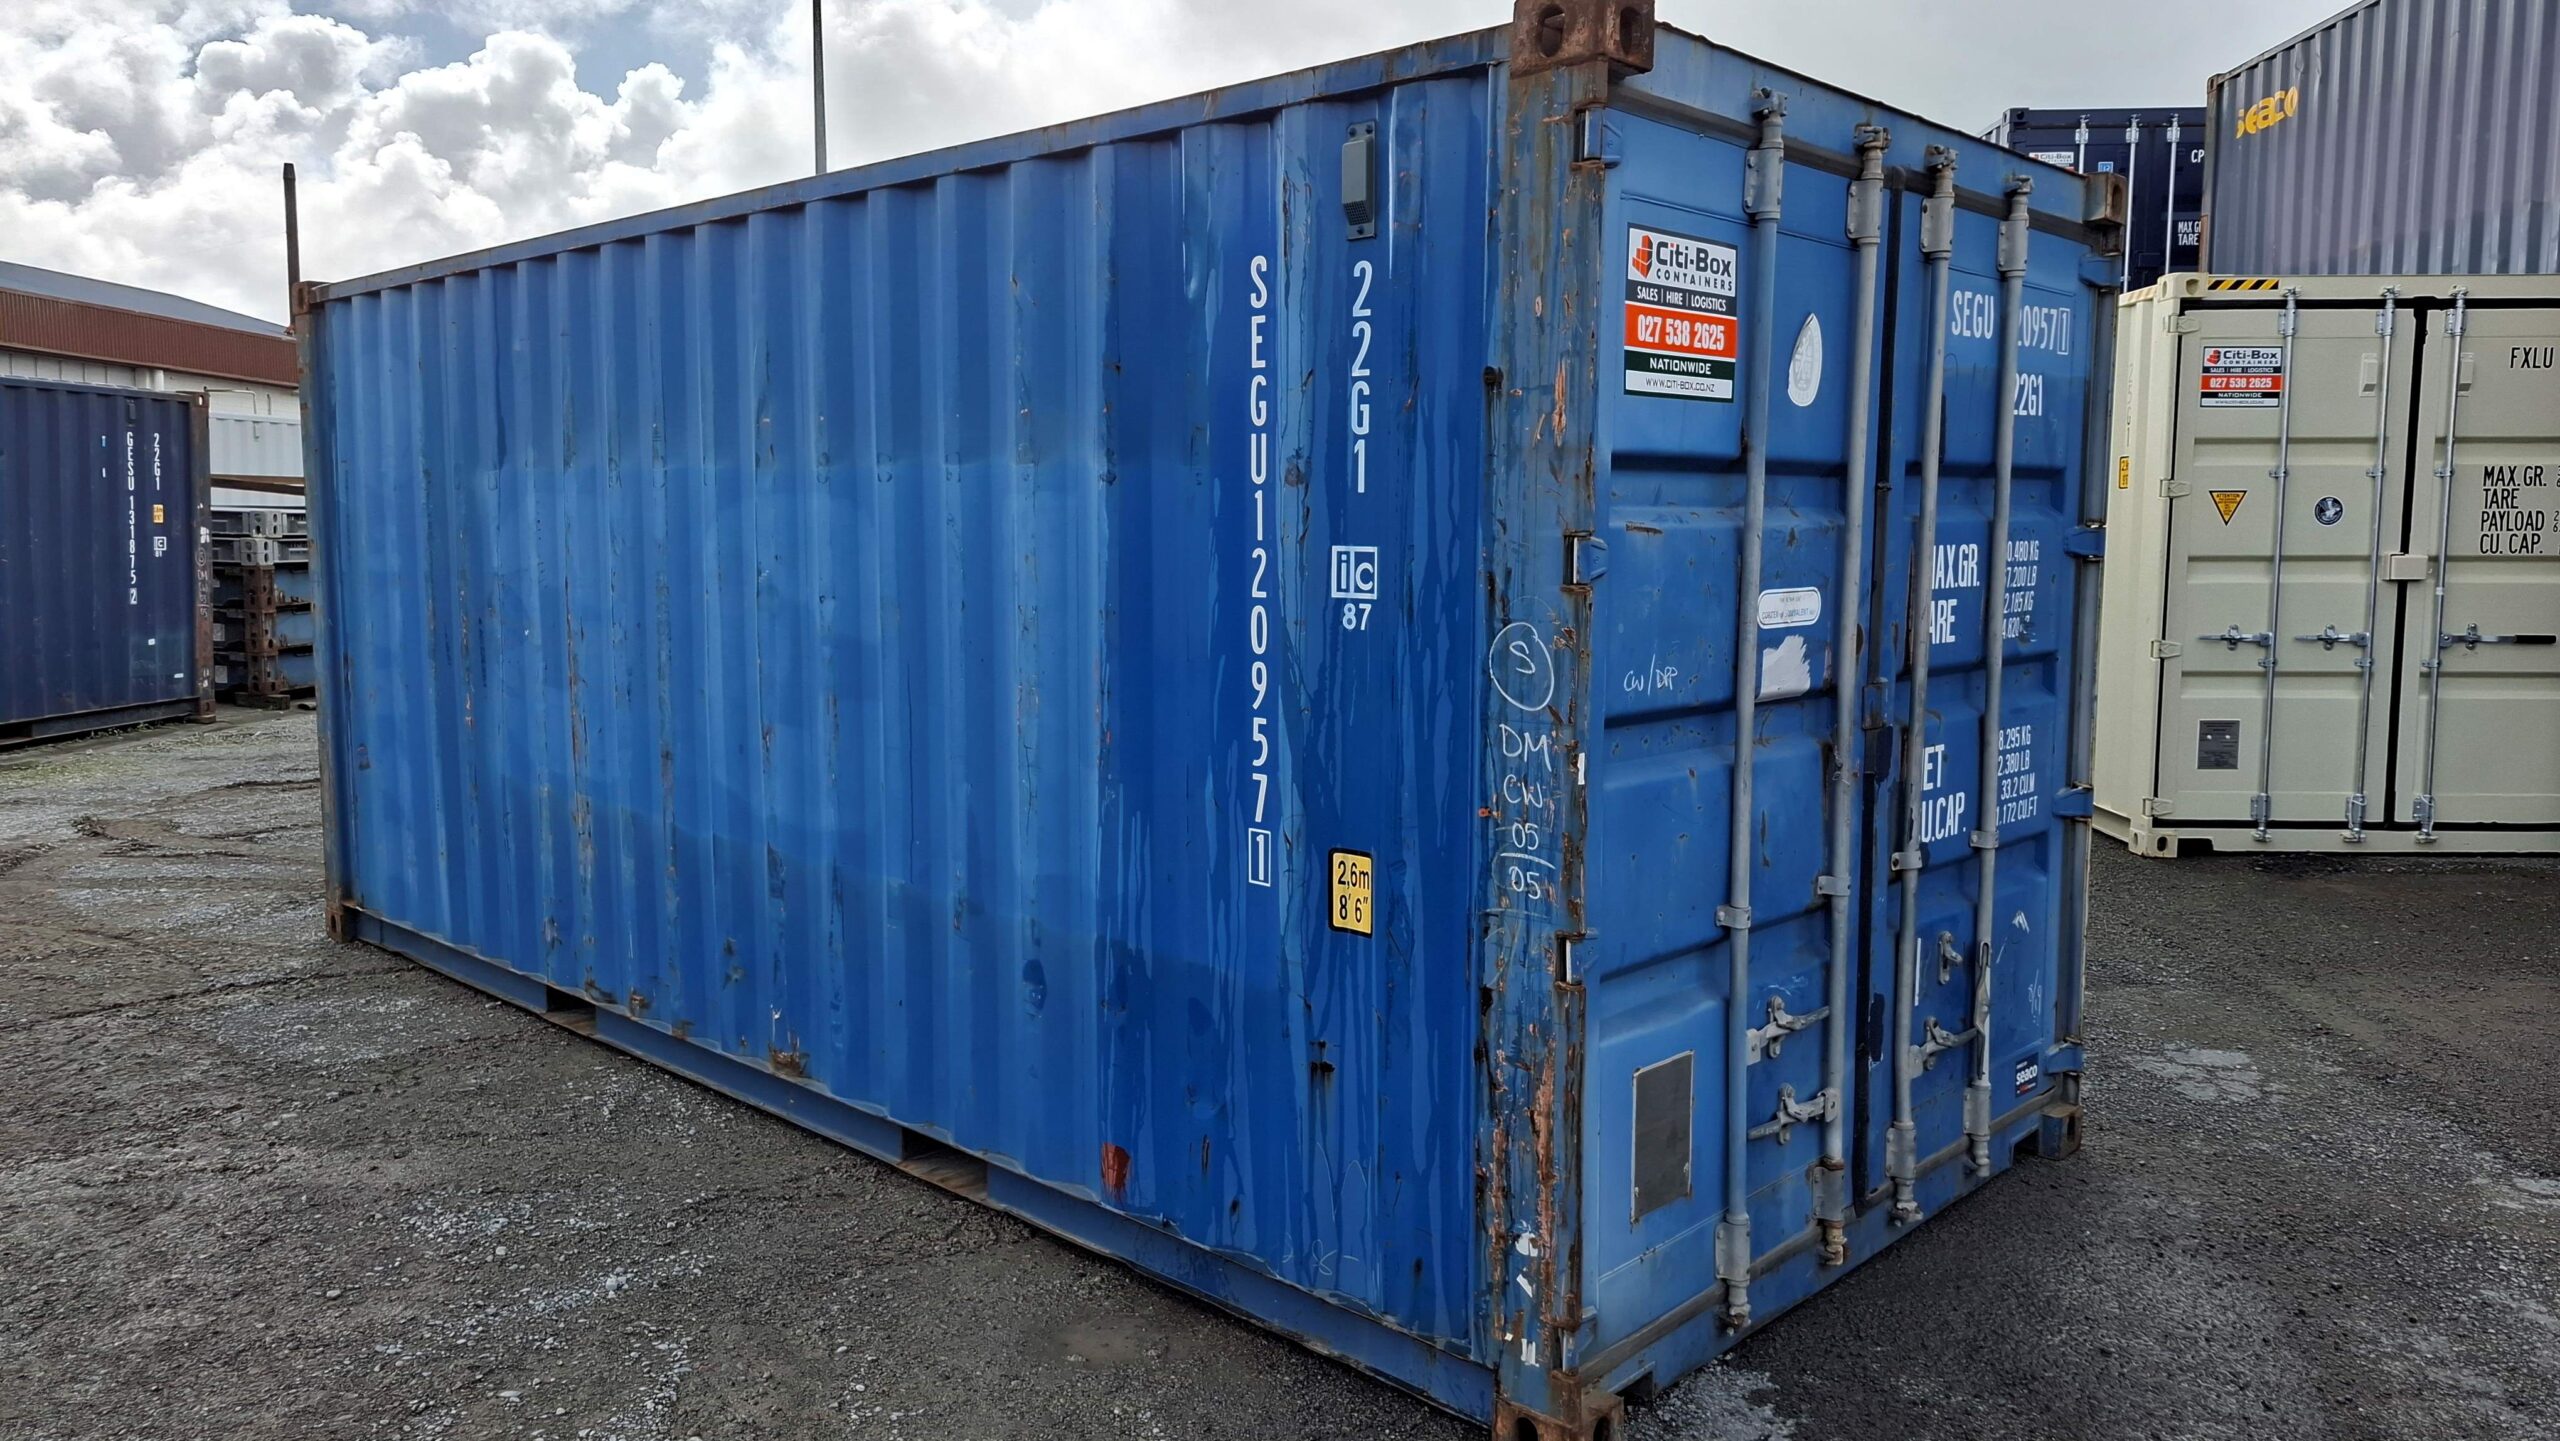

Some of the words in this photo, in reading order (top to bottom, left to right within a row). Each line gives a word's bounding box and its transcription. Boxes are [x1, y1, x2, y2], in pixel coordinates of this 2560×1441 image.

[2191, 149, 2205, 163] CP
[2178, 221, 2193, 233] MAX
[2178, 234, 2199, 246] TARE
[1656, 241, 1732, 278] Citi-Box
[1656, 268, 1732, 292] CONTAINERS
[1637, 286, 1658, 302] SALES
[1666, 291, 1683, 305] HIRE
[1691, 295, 1726, 311] LOGISTICS
[1952, 290, 1994, 339] SEGU
[1637, 314, 1662, 343] 027
[1665, 318, 1690, 347] 538
[1693, 322, 1725, 351] 2625
[1649, 357, 1711, 375] NATIONWIDE
[2223, 350, 2278, 360] Citi-Box
[2510, 347, 2554, 369] FXLU
[1351, 260, 1373, 493] 22G1
[2210, 377, 2227, 388] 027
[2249, 377, 2272, 388] 2625
[153, 433, 161, 491] 22G1
[2523, 465, 2547, 487] GR.
[2483, 488, 2520, 510] TARE
[2480, 510, 2545, 532] PAYLOAD
[2007, 540, 2029, 562] 0.480
[2029, 540, 2040, 561] KG
[2480, 533, 2503, 555] CU.
[2508, 533, 2543, 555] CAP.
[2006, 566, 2027, 588] 7.200
[2027, 565, 2038, 587] LB
[2023, 591, 2034, 611] KG
[1342, 603, 1372, 630] 87
[1499, 723, 1552, 772] DM
[1920, 744, 1945, 791] ET
[2021, 725, 2032, 746] KG
[2020, 749, 2030, 771] LB
[1920, 792, 1966, 843] U.CAP.
[2001, 777, 2018, 801] 33.2
[1512, 822, 1539, 850] 05
